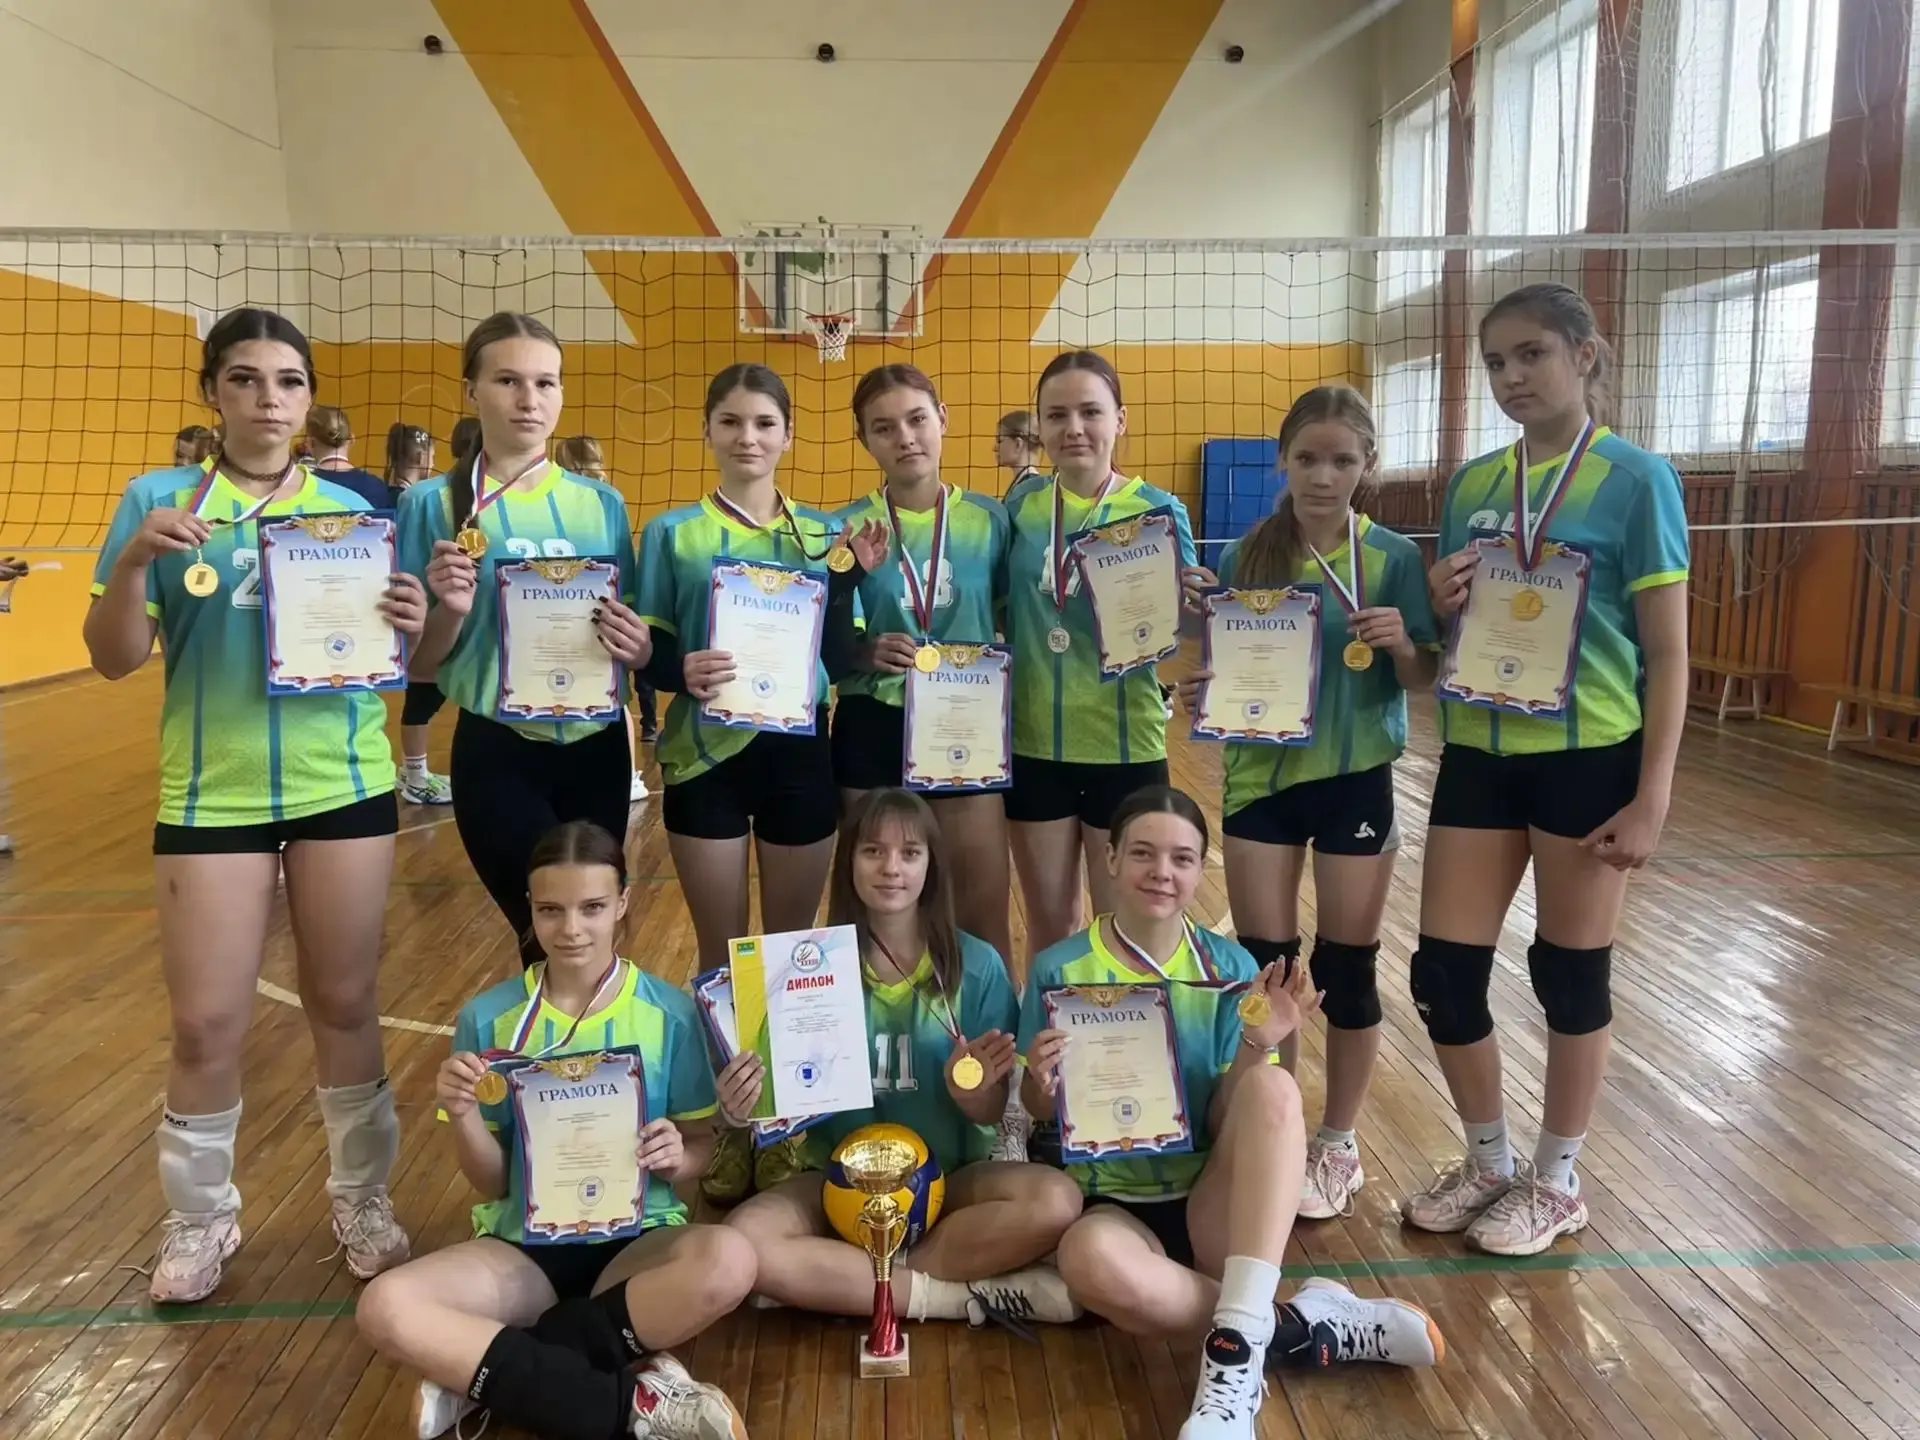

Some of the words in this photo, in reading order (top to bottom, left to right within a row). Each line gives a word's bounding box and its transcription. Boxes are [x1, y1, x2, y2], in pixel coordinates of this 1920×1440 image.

[288, 547, 372, 561] ГРАМОТА
[1097, 543, 1160, 569] ГРАМОТА
[1489, 567, 1564, 590] ГРАМОТА
[522, 588, 597, 600] ГРАМОТА
[732, 594, 801, 615] ГРАМОТА
[1226, 619, 1297, 631] ГРАМОТА
[927, 671, 991, 685] ГРАМОТА
[787, 975, 834, 991] ДИПЛОМ
[1071, 1009, 1147, 1025] ГРАМОТА
[872, 1033, 919, 1092] 11
[538, 1082, 619, 1103] ГРАМОТА
